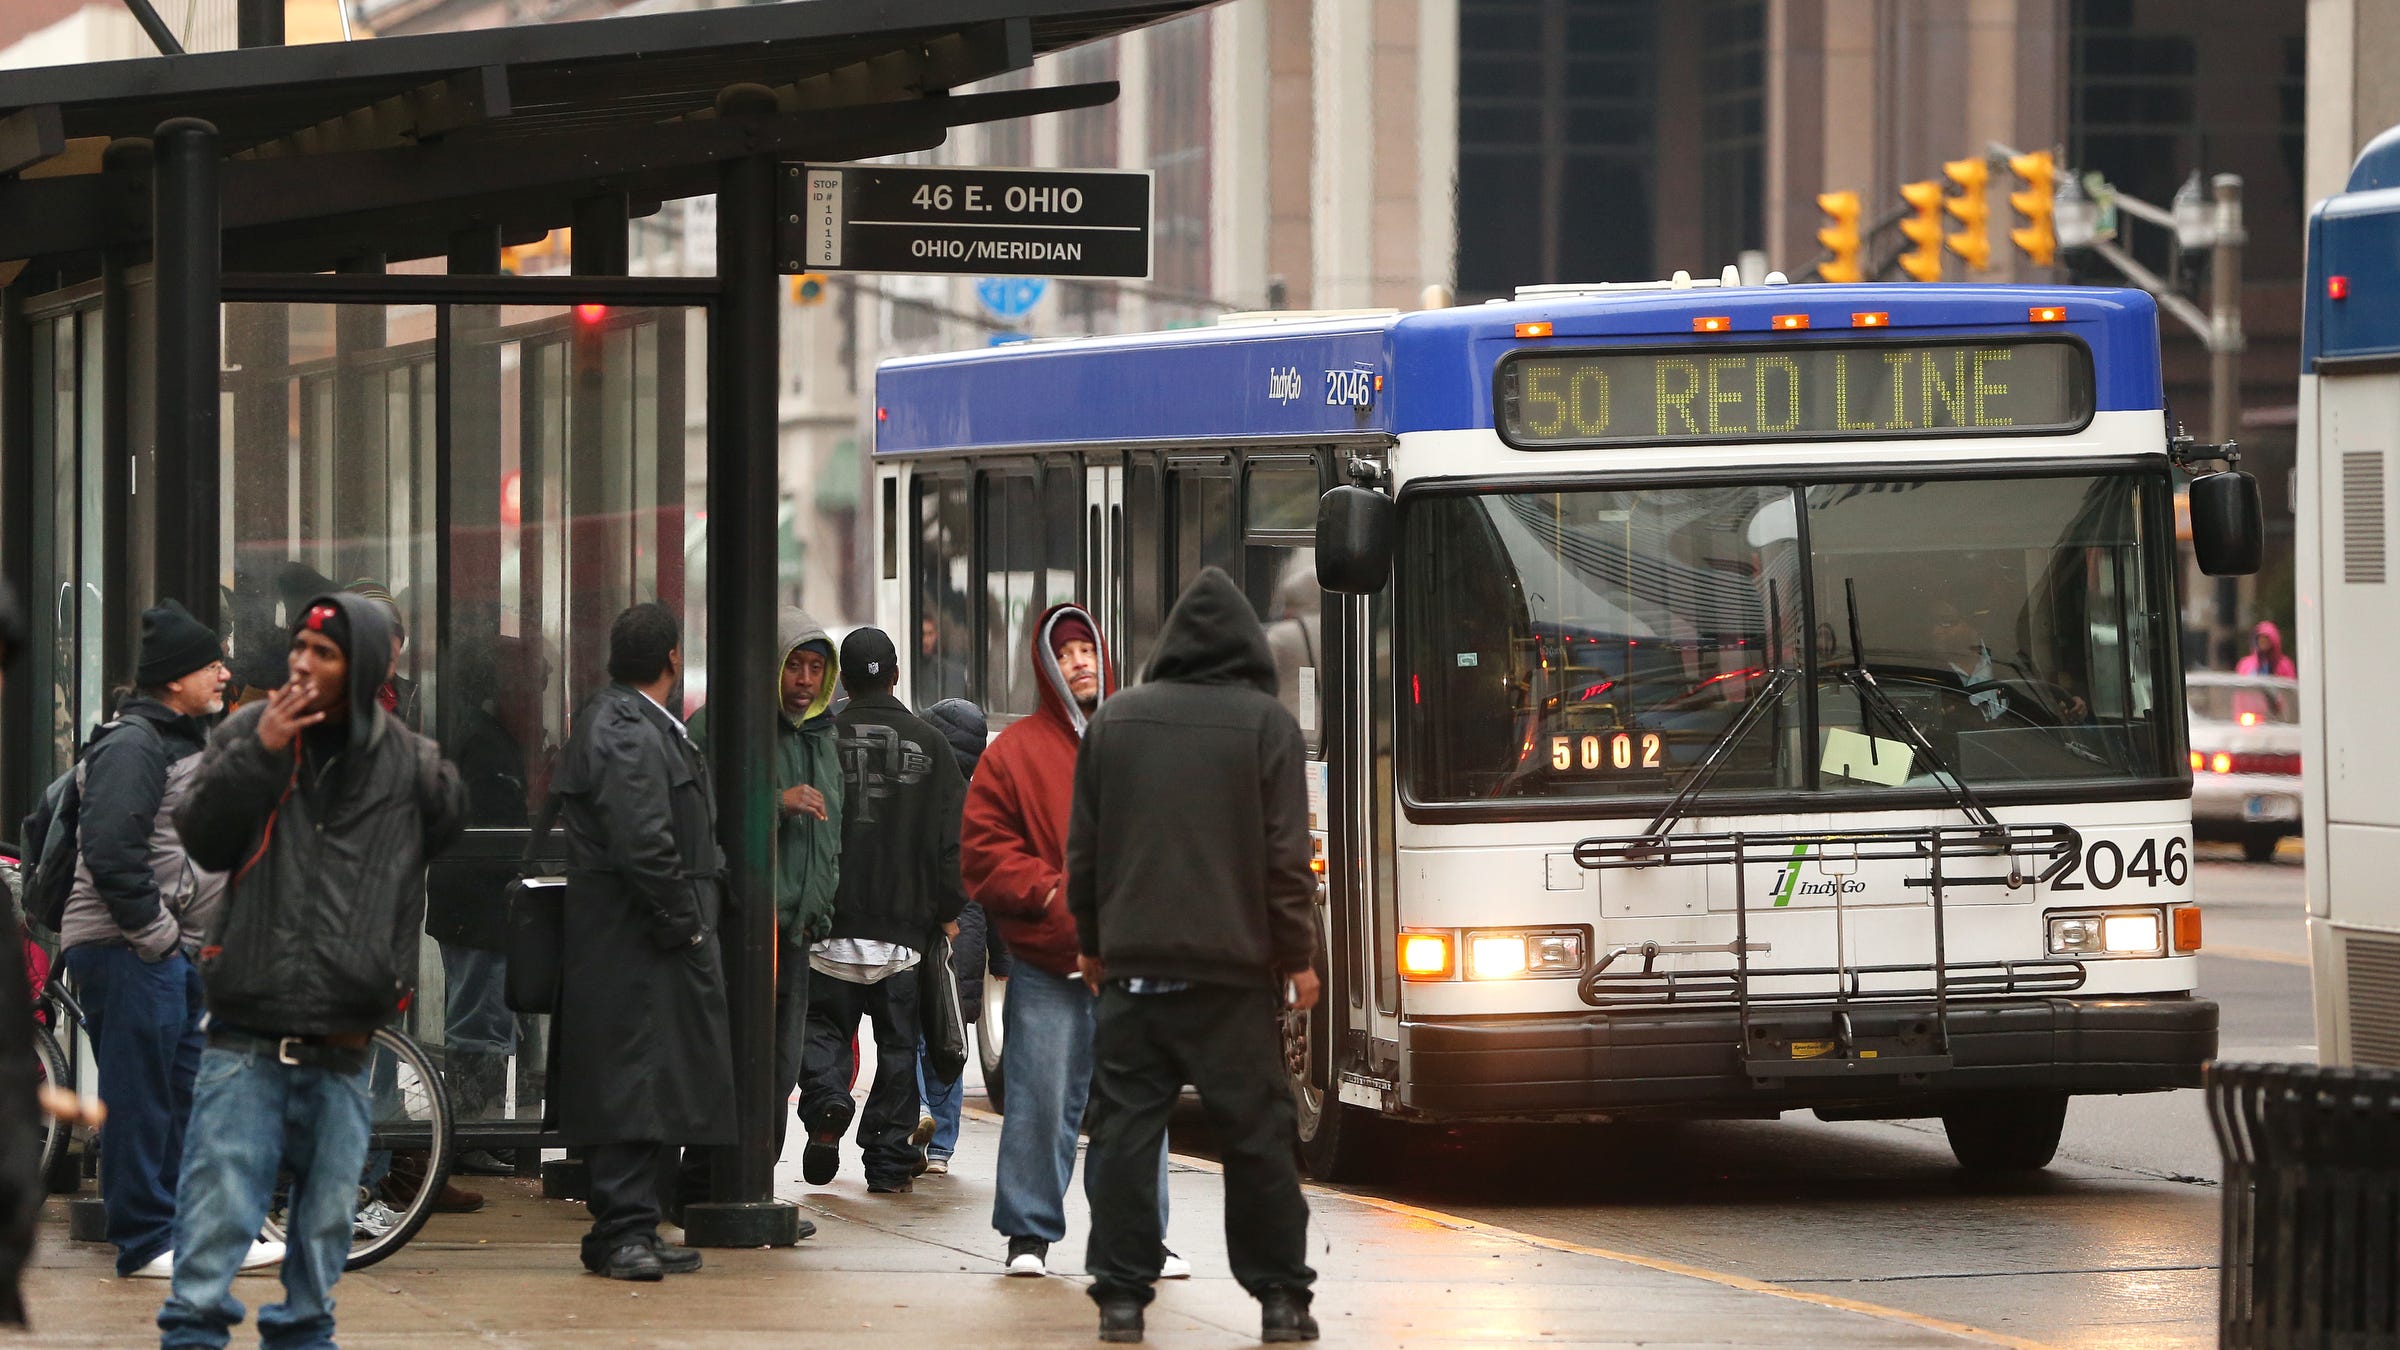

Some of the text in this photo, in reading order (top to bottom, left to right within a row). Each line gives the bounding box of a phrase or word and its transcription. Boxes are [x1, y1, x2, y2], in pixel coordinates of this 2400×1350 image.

[813, 180, 838, 188] STOP
[813, 193, 832, 201] ID #
[912, 184, 1083, 213] 46 E. OHIO
[911, 239, 1081, 262] OHIO/MERIDIAN
[1269, 366, 1301, 406] IndyGo
[1326, 371, 1369, 405] 2046
[1527, 349, 2013, 435] 50 RED LINE
[1551, 733, 1661, 770] 5002
[2049, 836, 2188, 891] 2046
[1799, 879, 1866, 896] IndyGo
